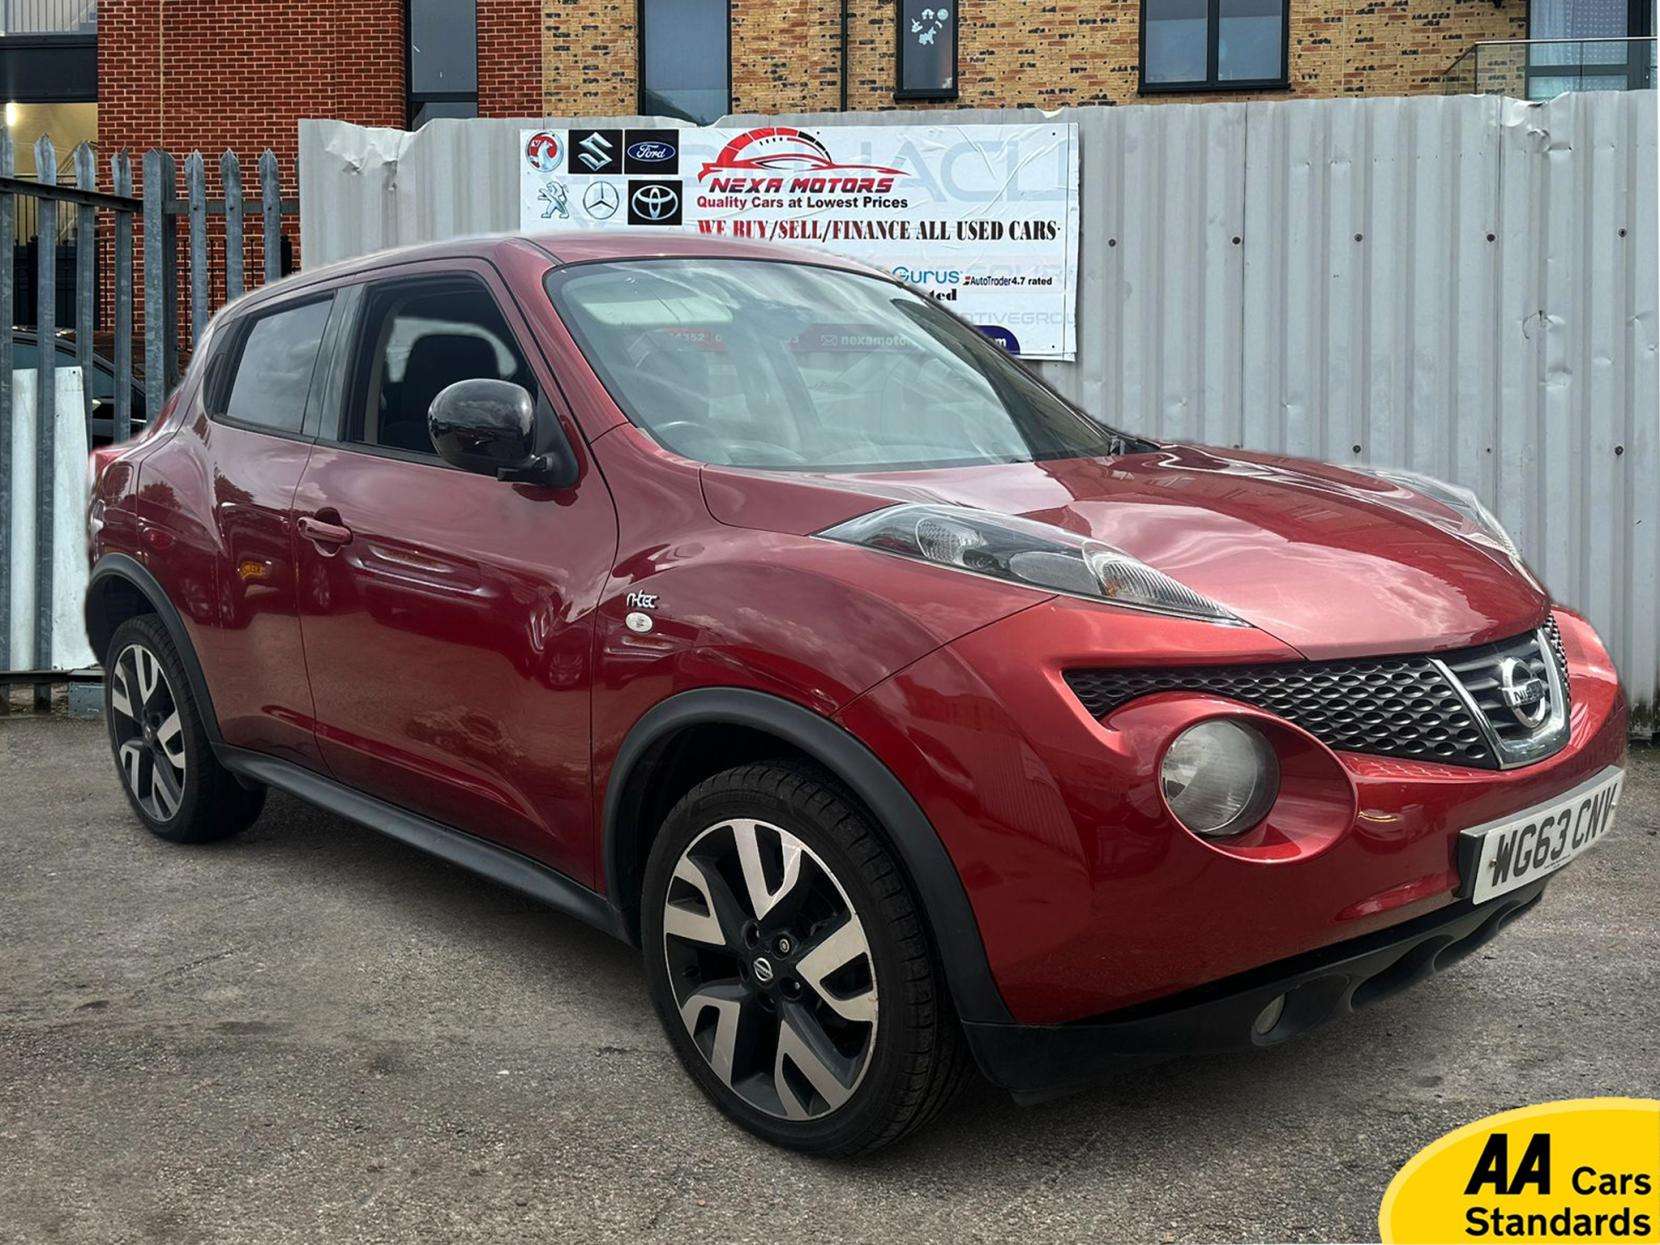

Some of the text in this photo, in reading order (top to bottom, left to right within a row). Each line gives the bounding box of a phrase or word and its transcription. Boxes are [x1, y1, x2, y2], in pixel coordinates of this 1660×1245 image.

[637, 143, 667, 159] Ford
[709, 177, 895, 193] NEXA MOTORS
[697, 196, 908, 210] Quality Cars at Lowest Prices
[697, 219, 1057, 242] WE BUY/SELL/FINANCE ALL USED CARS
[1027, 276, 1053, 286] rated
[1491, 783, 1618, 888] WG63 CNV
